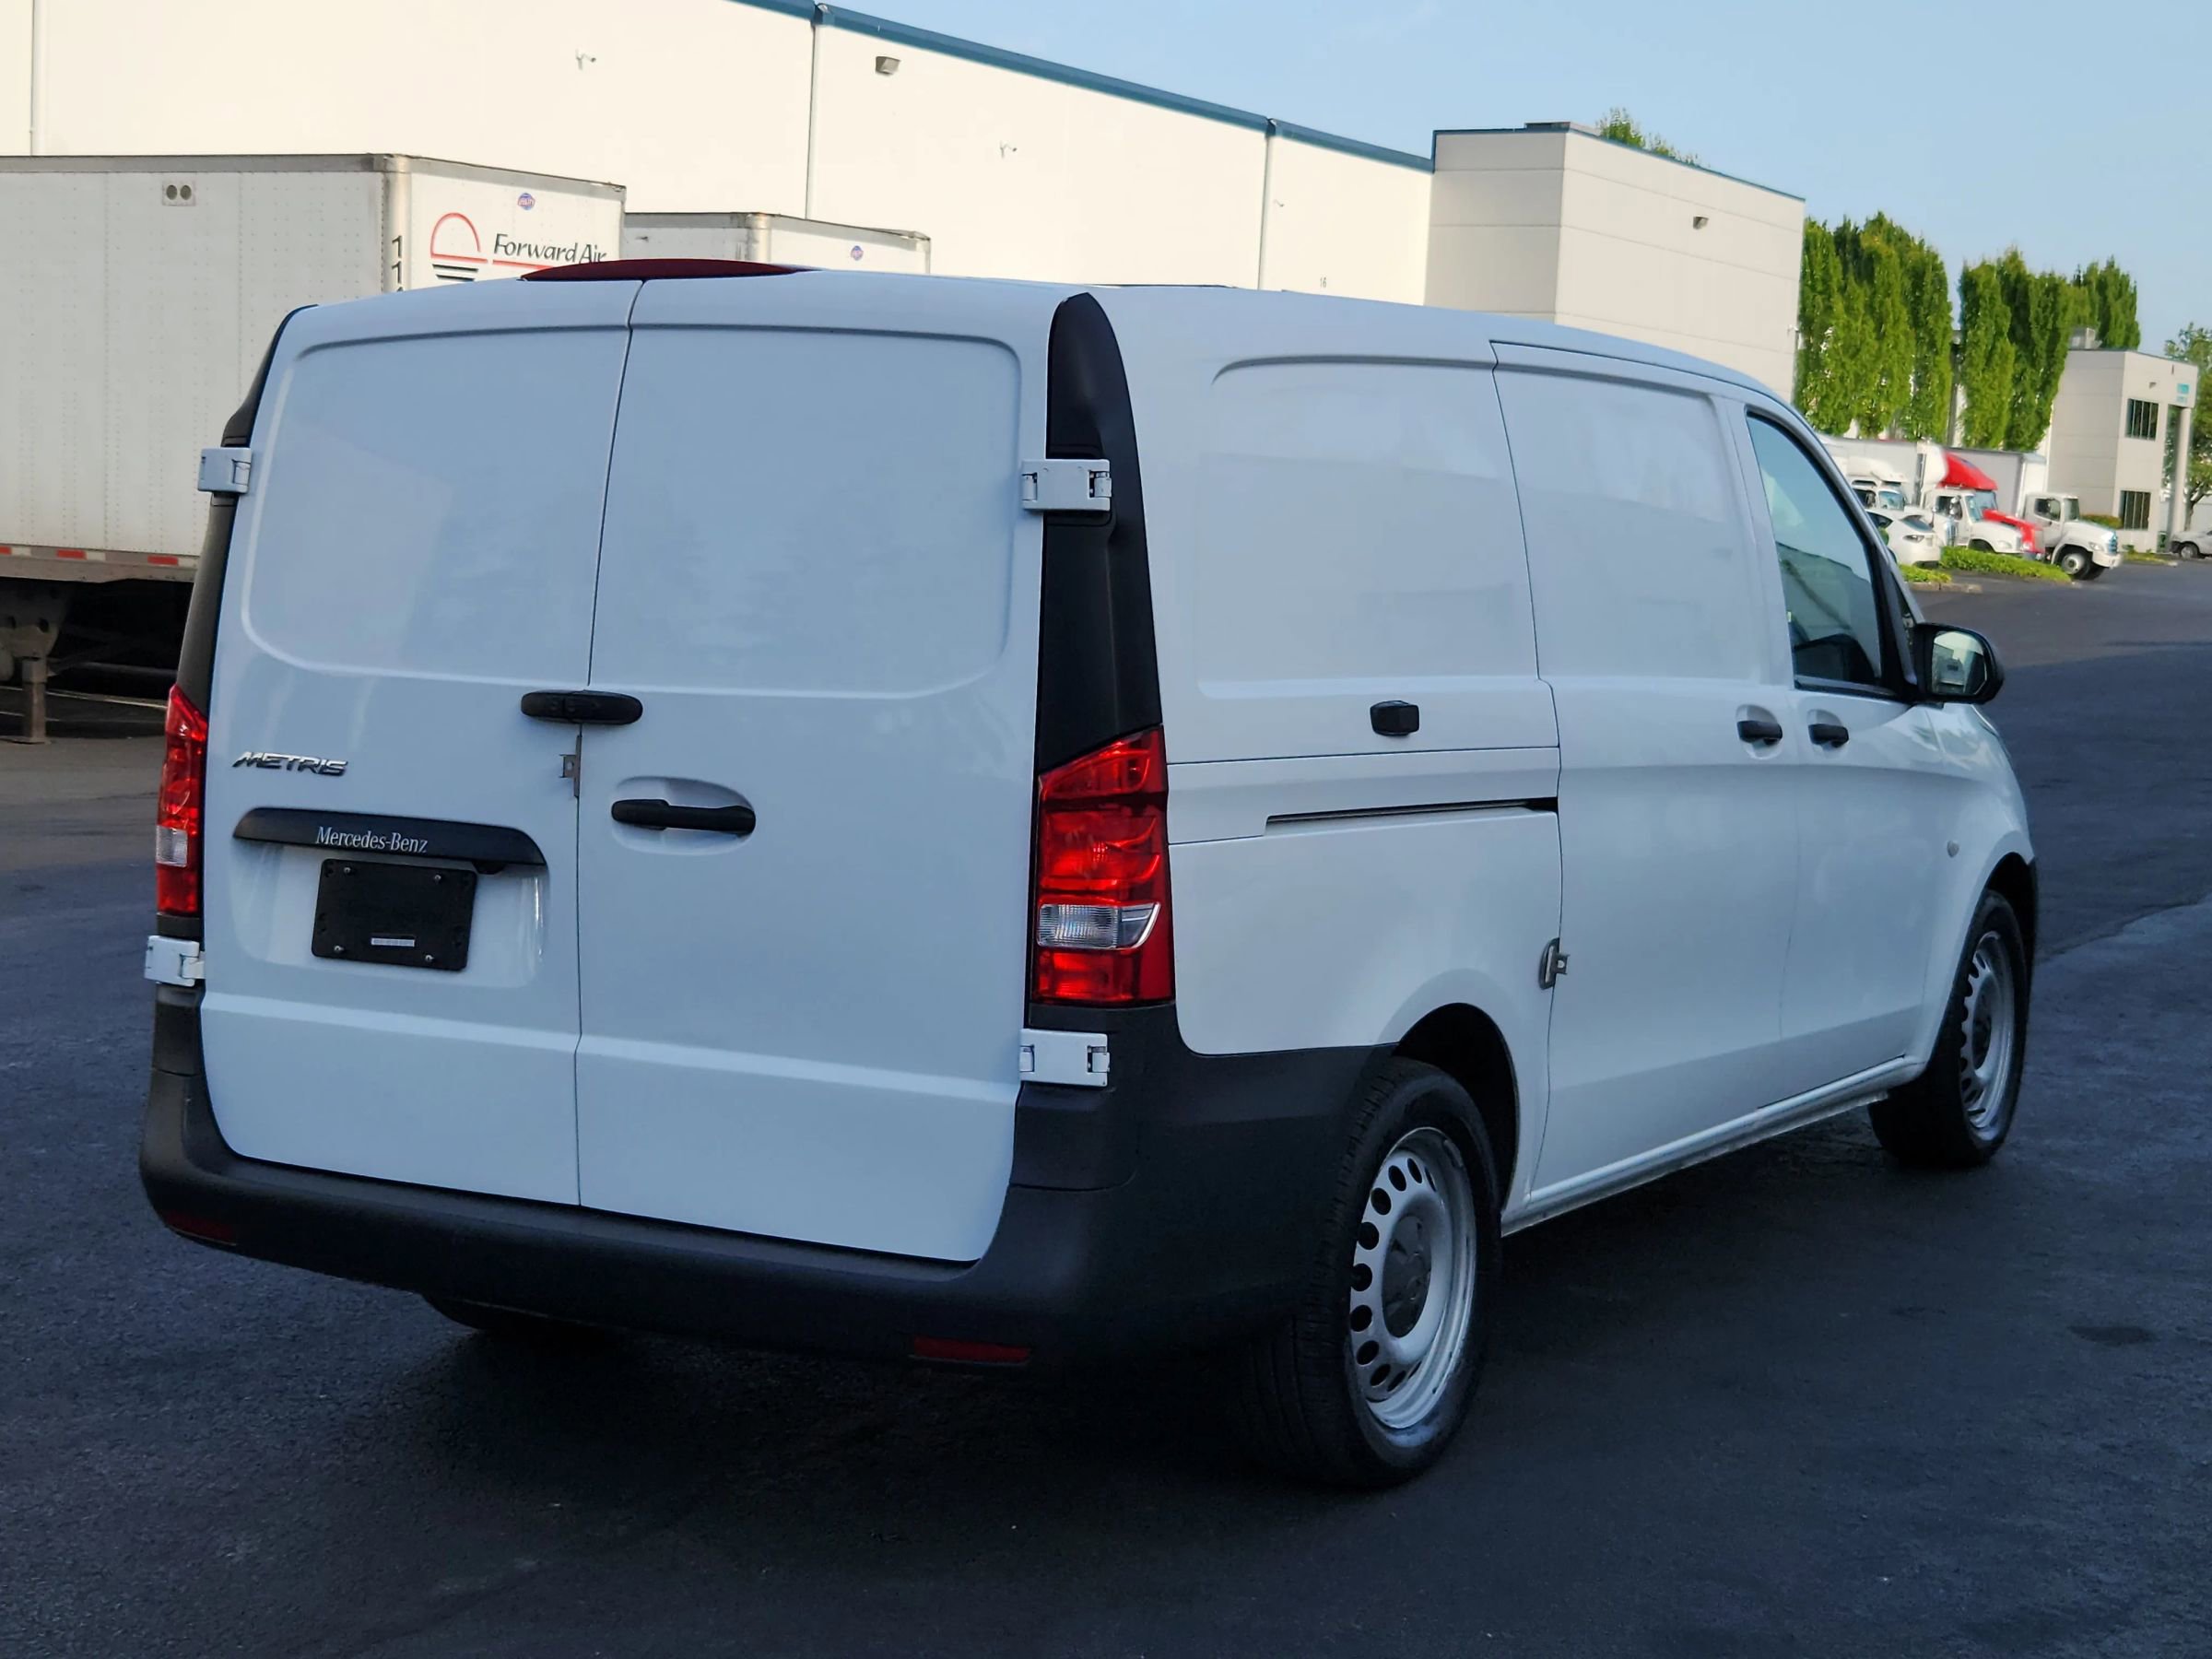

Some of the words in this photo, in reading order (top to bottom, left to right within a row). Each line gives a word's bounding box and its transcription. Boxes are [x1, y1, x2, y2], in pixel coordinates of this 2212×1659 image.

[391, 234, 404, 292] 11
[493, 232, 579, 264] Forward
[578, 243, 607, 265] Air
[231, 751, 348, 777] METRIS
[315, 826, 429, 853] Mercedes-Benz
